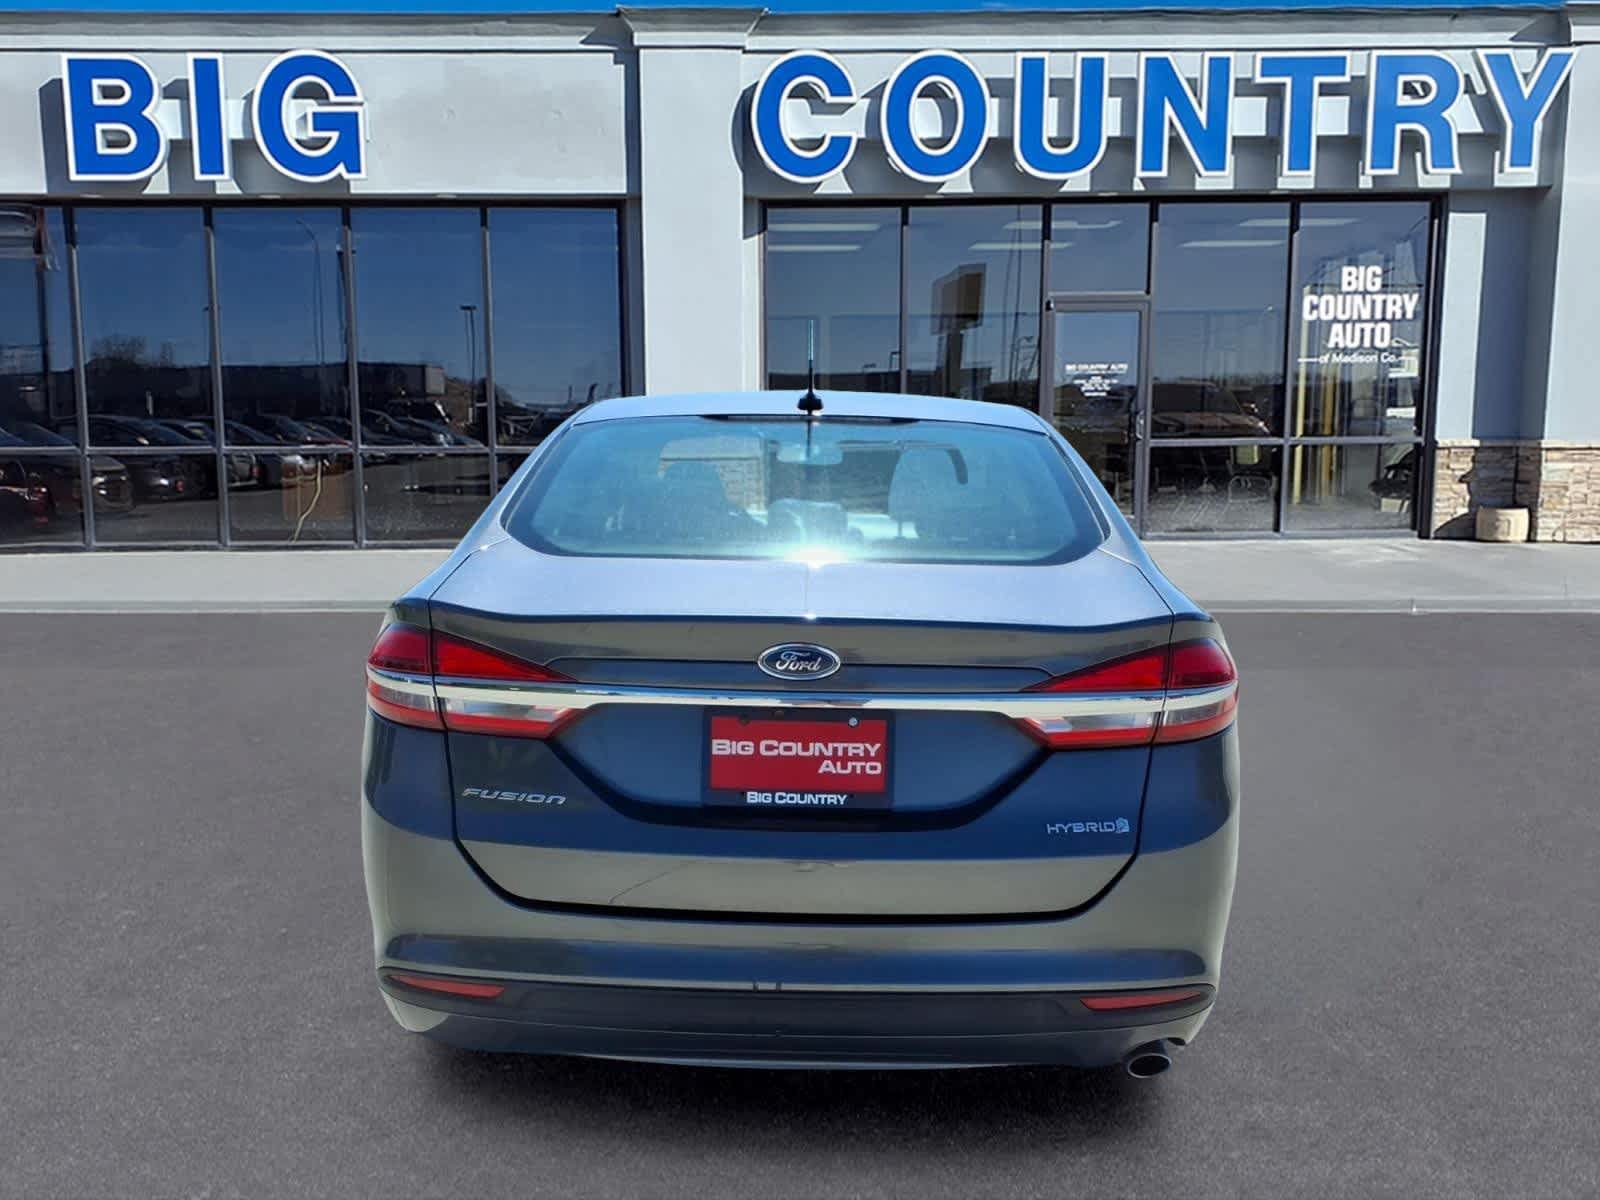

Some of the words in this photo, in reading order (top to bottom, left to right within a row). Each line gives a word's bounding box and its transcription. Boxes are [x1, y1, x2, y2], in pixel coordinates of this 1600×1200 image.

[61, 50, 367, 182] BIG
[751, 47, 1575, 184] COUNTRY
[1341, 265, 1382, 293] BIG
[1302, 292, 1420, 321] COUNTRY
[1327, 321, 1392, 349] AUTO
[1319, 352, 1330, 364] of
[1331, 352, 1378, 363] Madison
[775, 651, 821, 672] Ford
[711, 739, 755, 755] BIG
[759, 740, 881, 757] COUNTRY
[818, 760, 882, 775] AUTO
[462, 788, 567, 805] FUSION
[746, 791, 772, 804] BIG
[774, 792, 848, 805] COUNTRY
[1046, 821, 1116, 834] HYBRID
